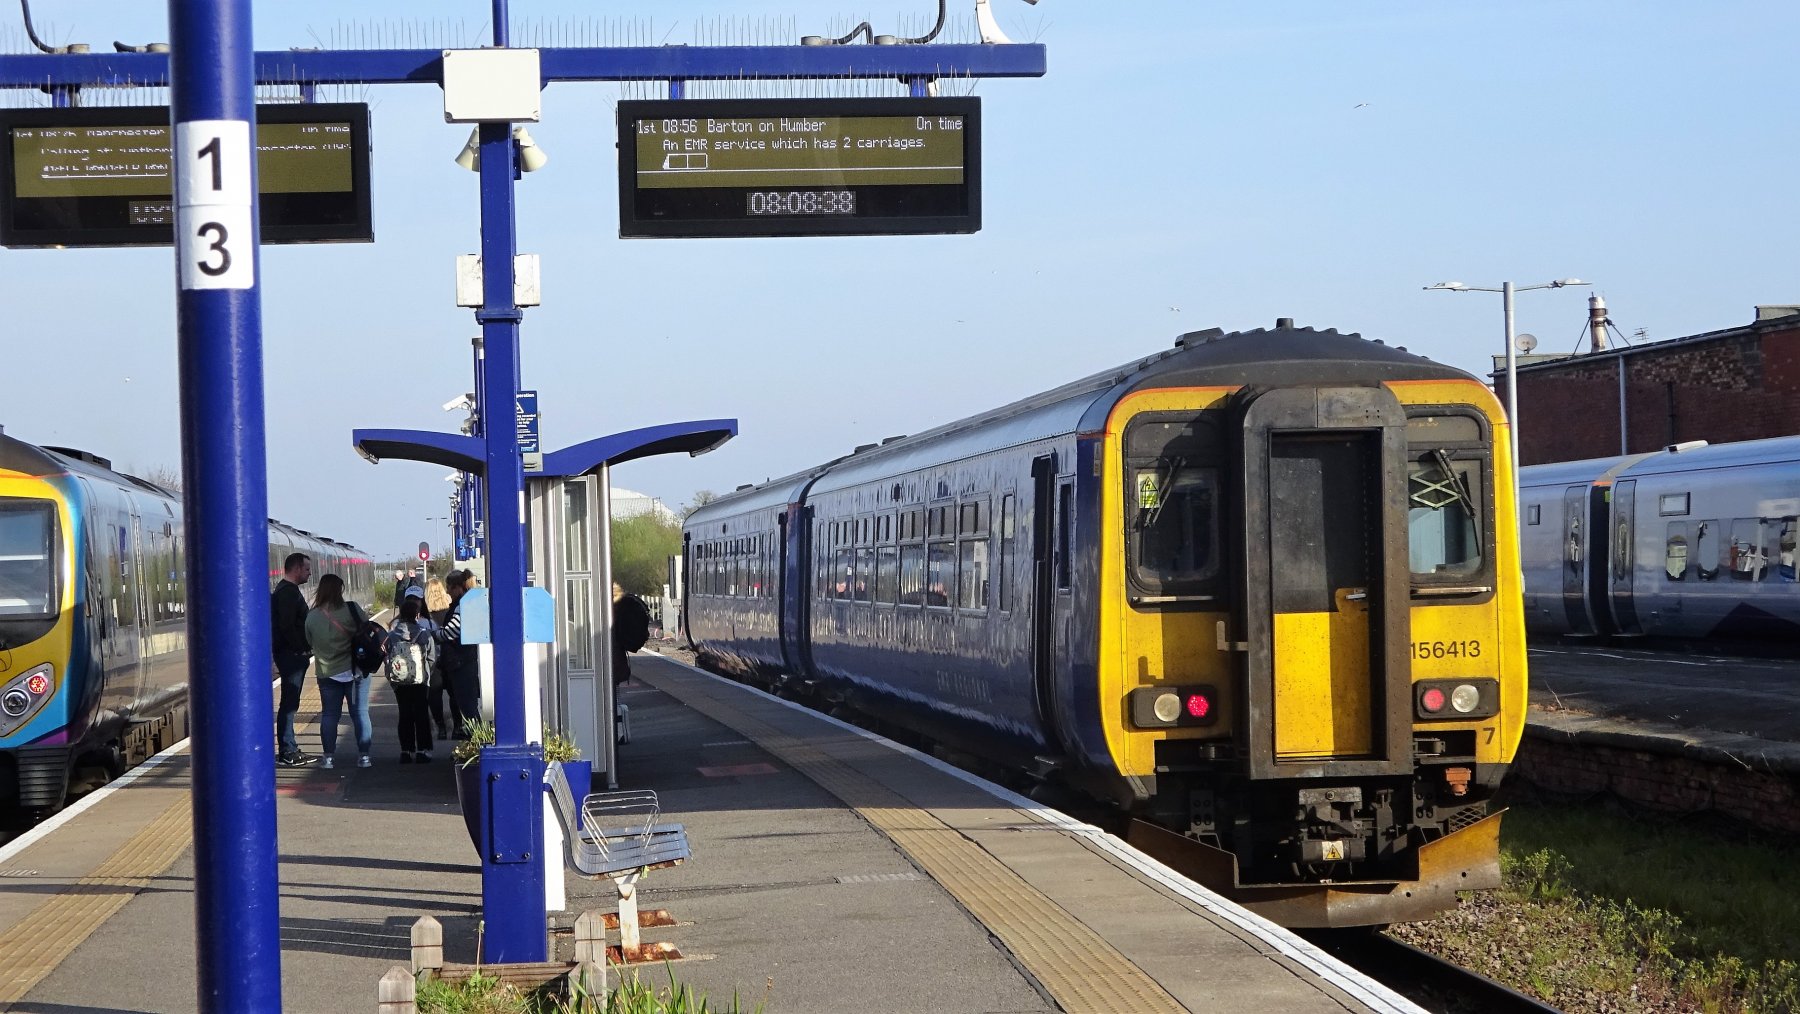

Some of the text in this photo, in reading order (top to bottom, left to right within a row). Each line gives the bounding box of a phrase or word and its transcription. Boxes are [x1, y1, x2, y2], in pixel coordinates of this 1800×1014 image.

[637, 117, 827, 134] 1st 08:56 Barton on Humber
[916, 116, 963, 131] On time
[662, 136, 926, 151] An EMR service which has 2 carriages.
[198, 137, 222, 191] 1
[751, 191, 853, 214] 08:08:38
[197, 221, 232, 276] 3
[1410, 640, 1481, 660] 156413
[1482, 727, 1496, 745] 7
